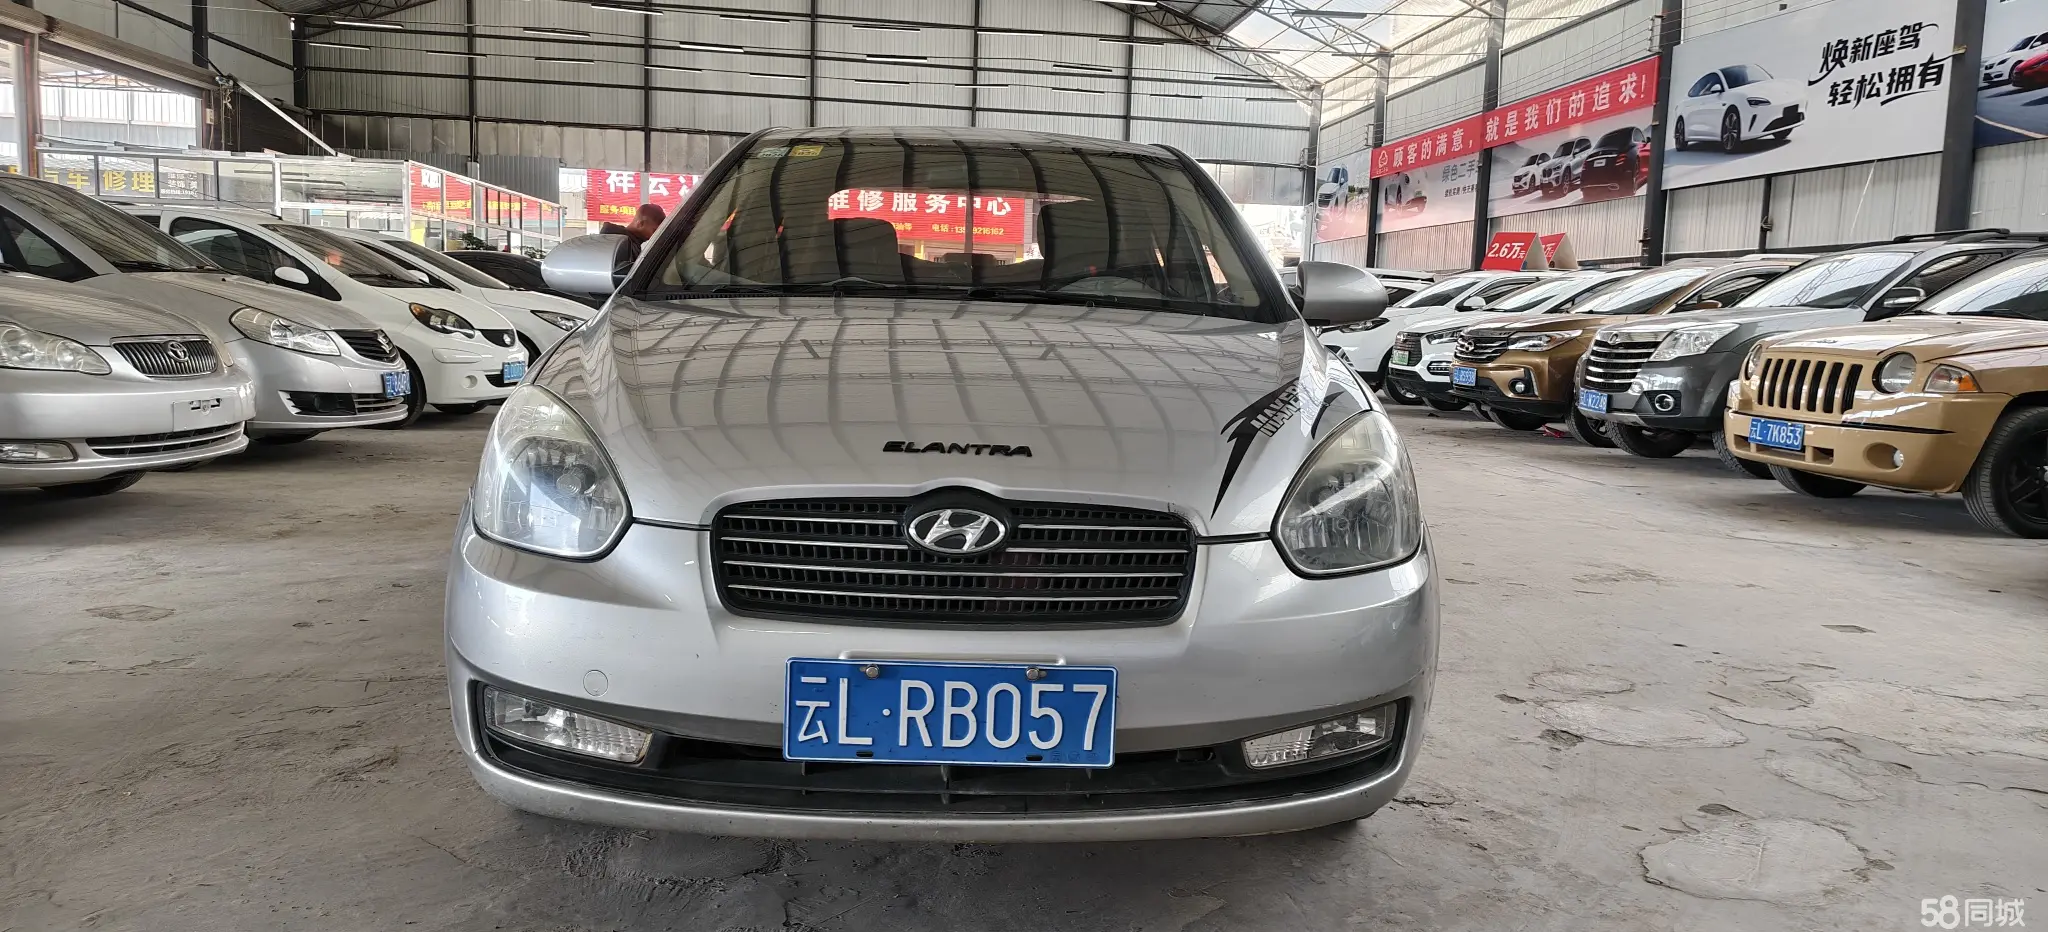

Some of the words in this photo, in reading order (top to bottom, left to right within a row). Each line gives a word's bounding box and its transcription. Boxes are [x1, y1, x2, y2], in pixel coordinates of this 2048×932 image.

[1815, 22, 1932, 80] 焕新座驾
[1827, 54, 1950, 108] 轻松拥有
[1442, 159, 1480, 184] 绿色二手
[1487, 242, 1526, 259] 2.6万元
[882, 440, 1033, 458] ELANTRA
[795, 676, 1108, 751] 云L·RB057
